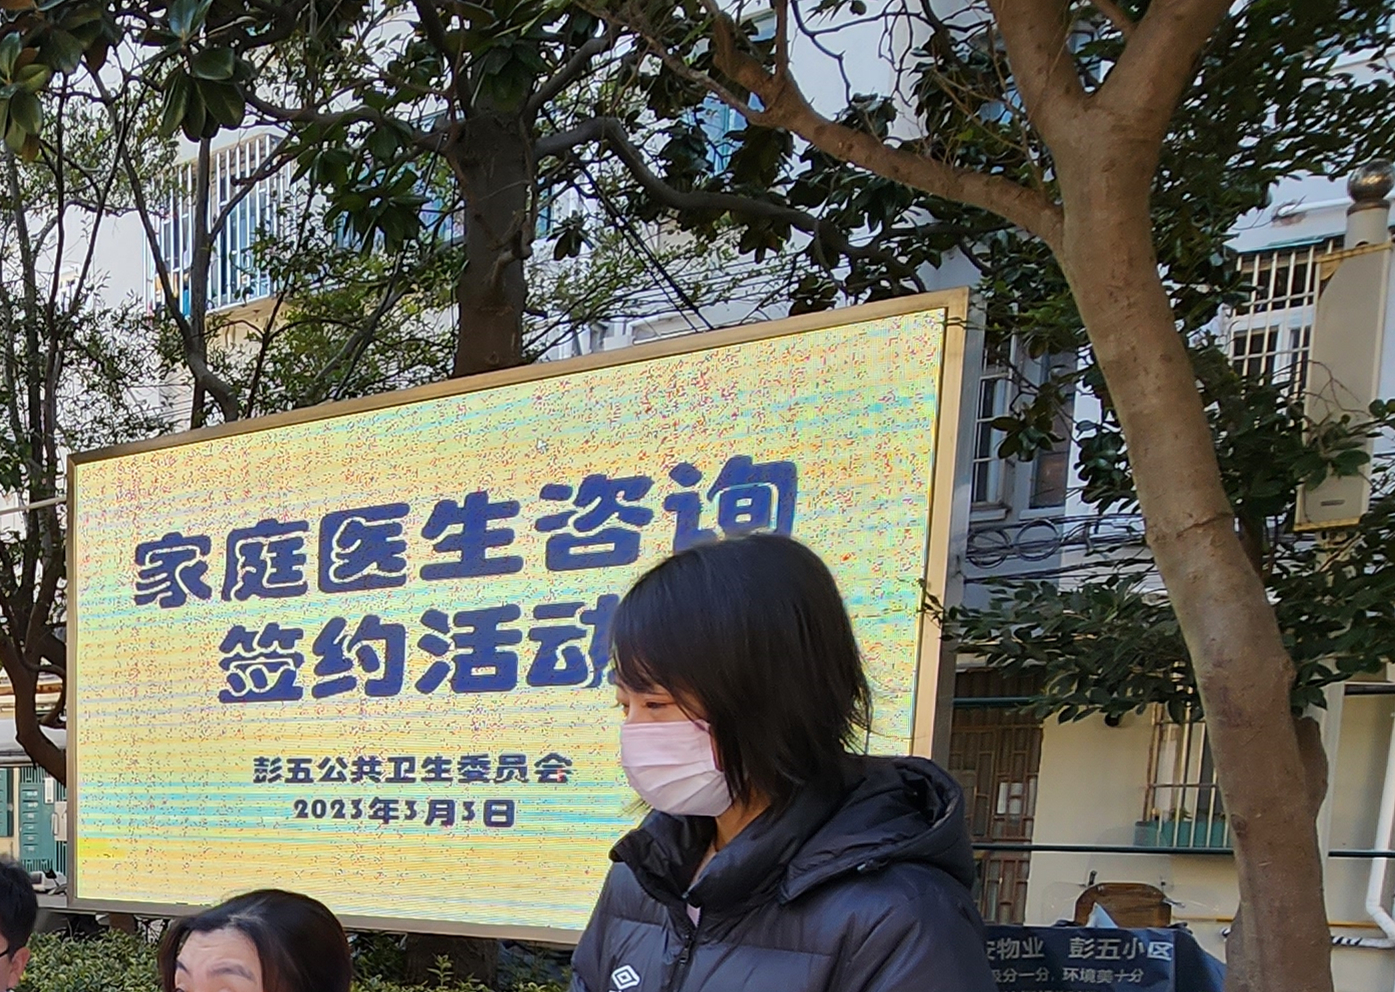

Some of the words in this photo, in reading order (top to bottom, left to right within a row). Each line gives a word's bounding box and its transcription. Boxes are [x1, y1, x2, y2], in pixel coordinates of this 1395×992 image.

[133, 456, 798, 609] 家庭医生咨询
[218, 592, 622, 704] 签约活动
[252, 752, 573, 784] 彭五公共卫生委员会
[293, 796, 516, 828] 2023年3月3日
[1068, 936, 1173, 961] 彭五小区
